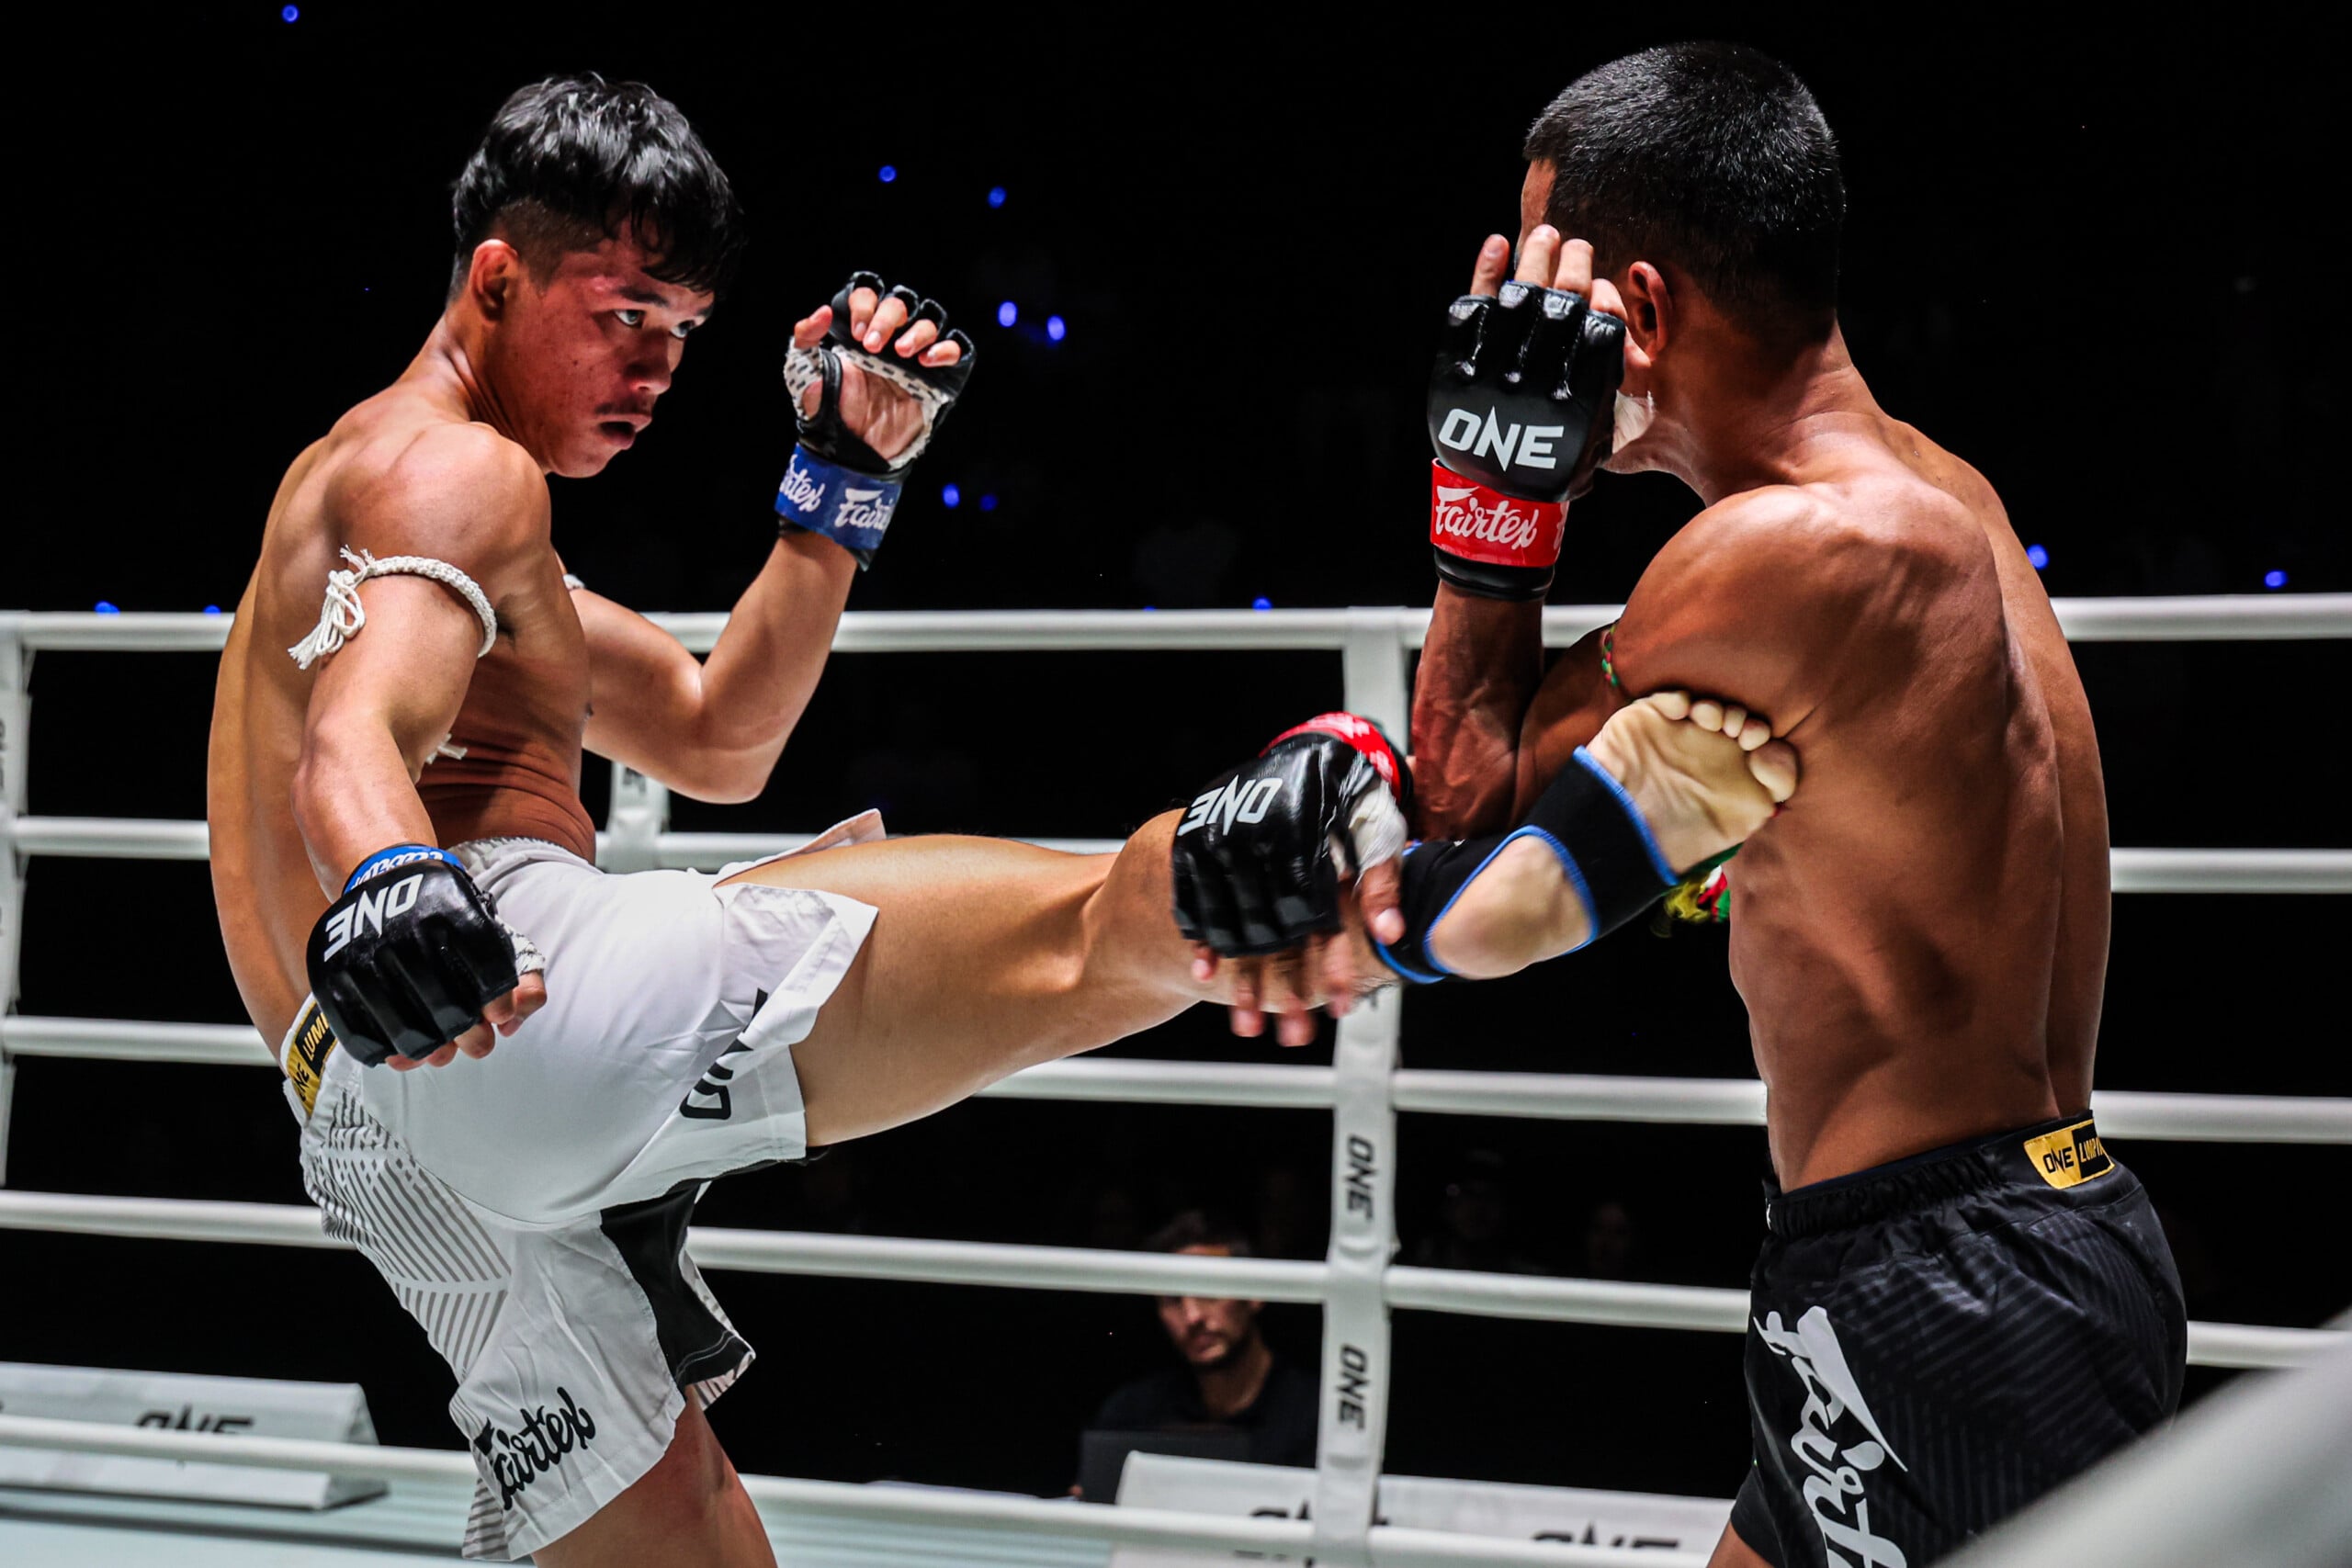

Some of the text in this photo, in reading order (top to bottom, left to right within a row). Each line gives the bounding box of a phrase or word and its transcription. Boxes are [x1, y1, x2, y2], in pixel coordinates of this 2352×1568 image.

[1438, 405, 1564, 472] ONE
[1435, 485, 1540, 550] Fairtex
[1177, 774, 1283, 837] ONE
[323, 874, 424, 963] ONE
[1345, 1134, 1378, 1220] ONE
[2042, 1145, 2075, 1174] ONE
[1337, 1345, 1369, 1431] ONE
[473, 1387, 595, 1511] Fairtex
